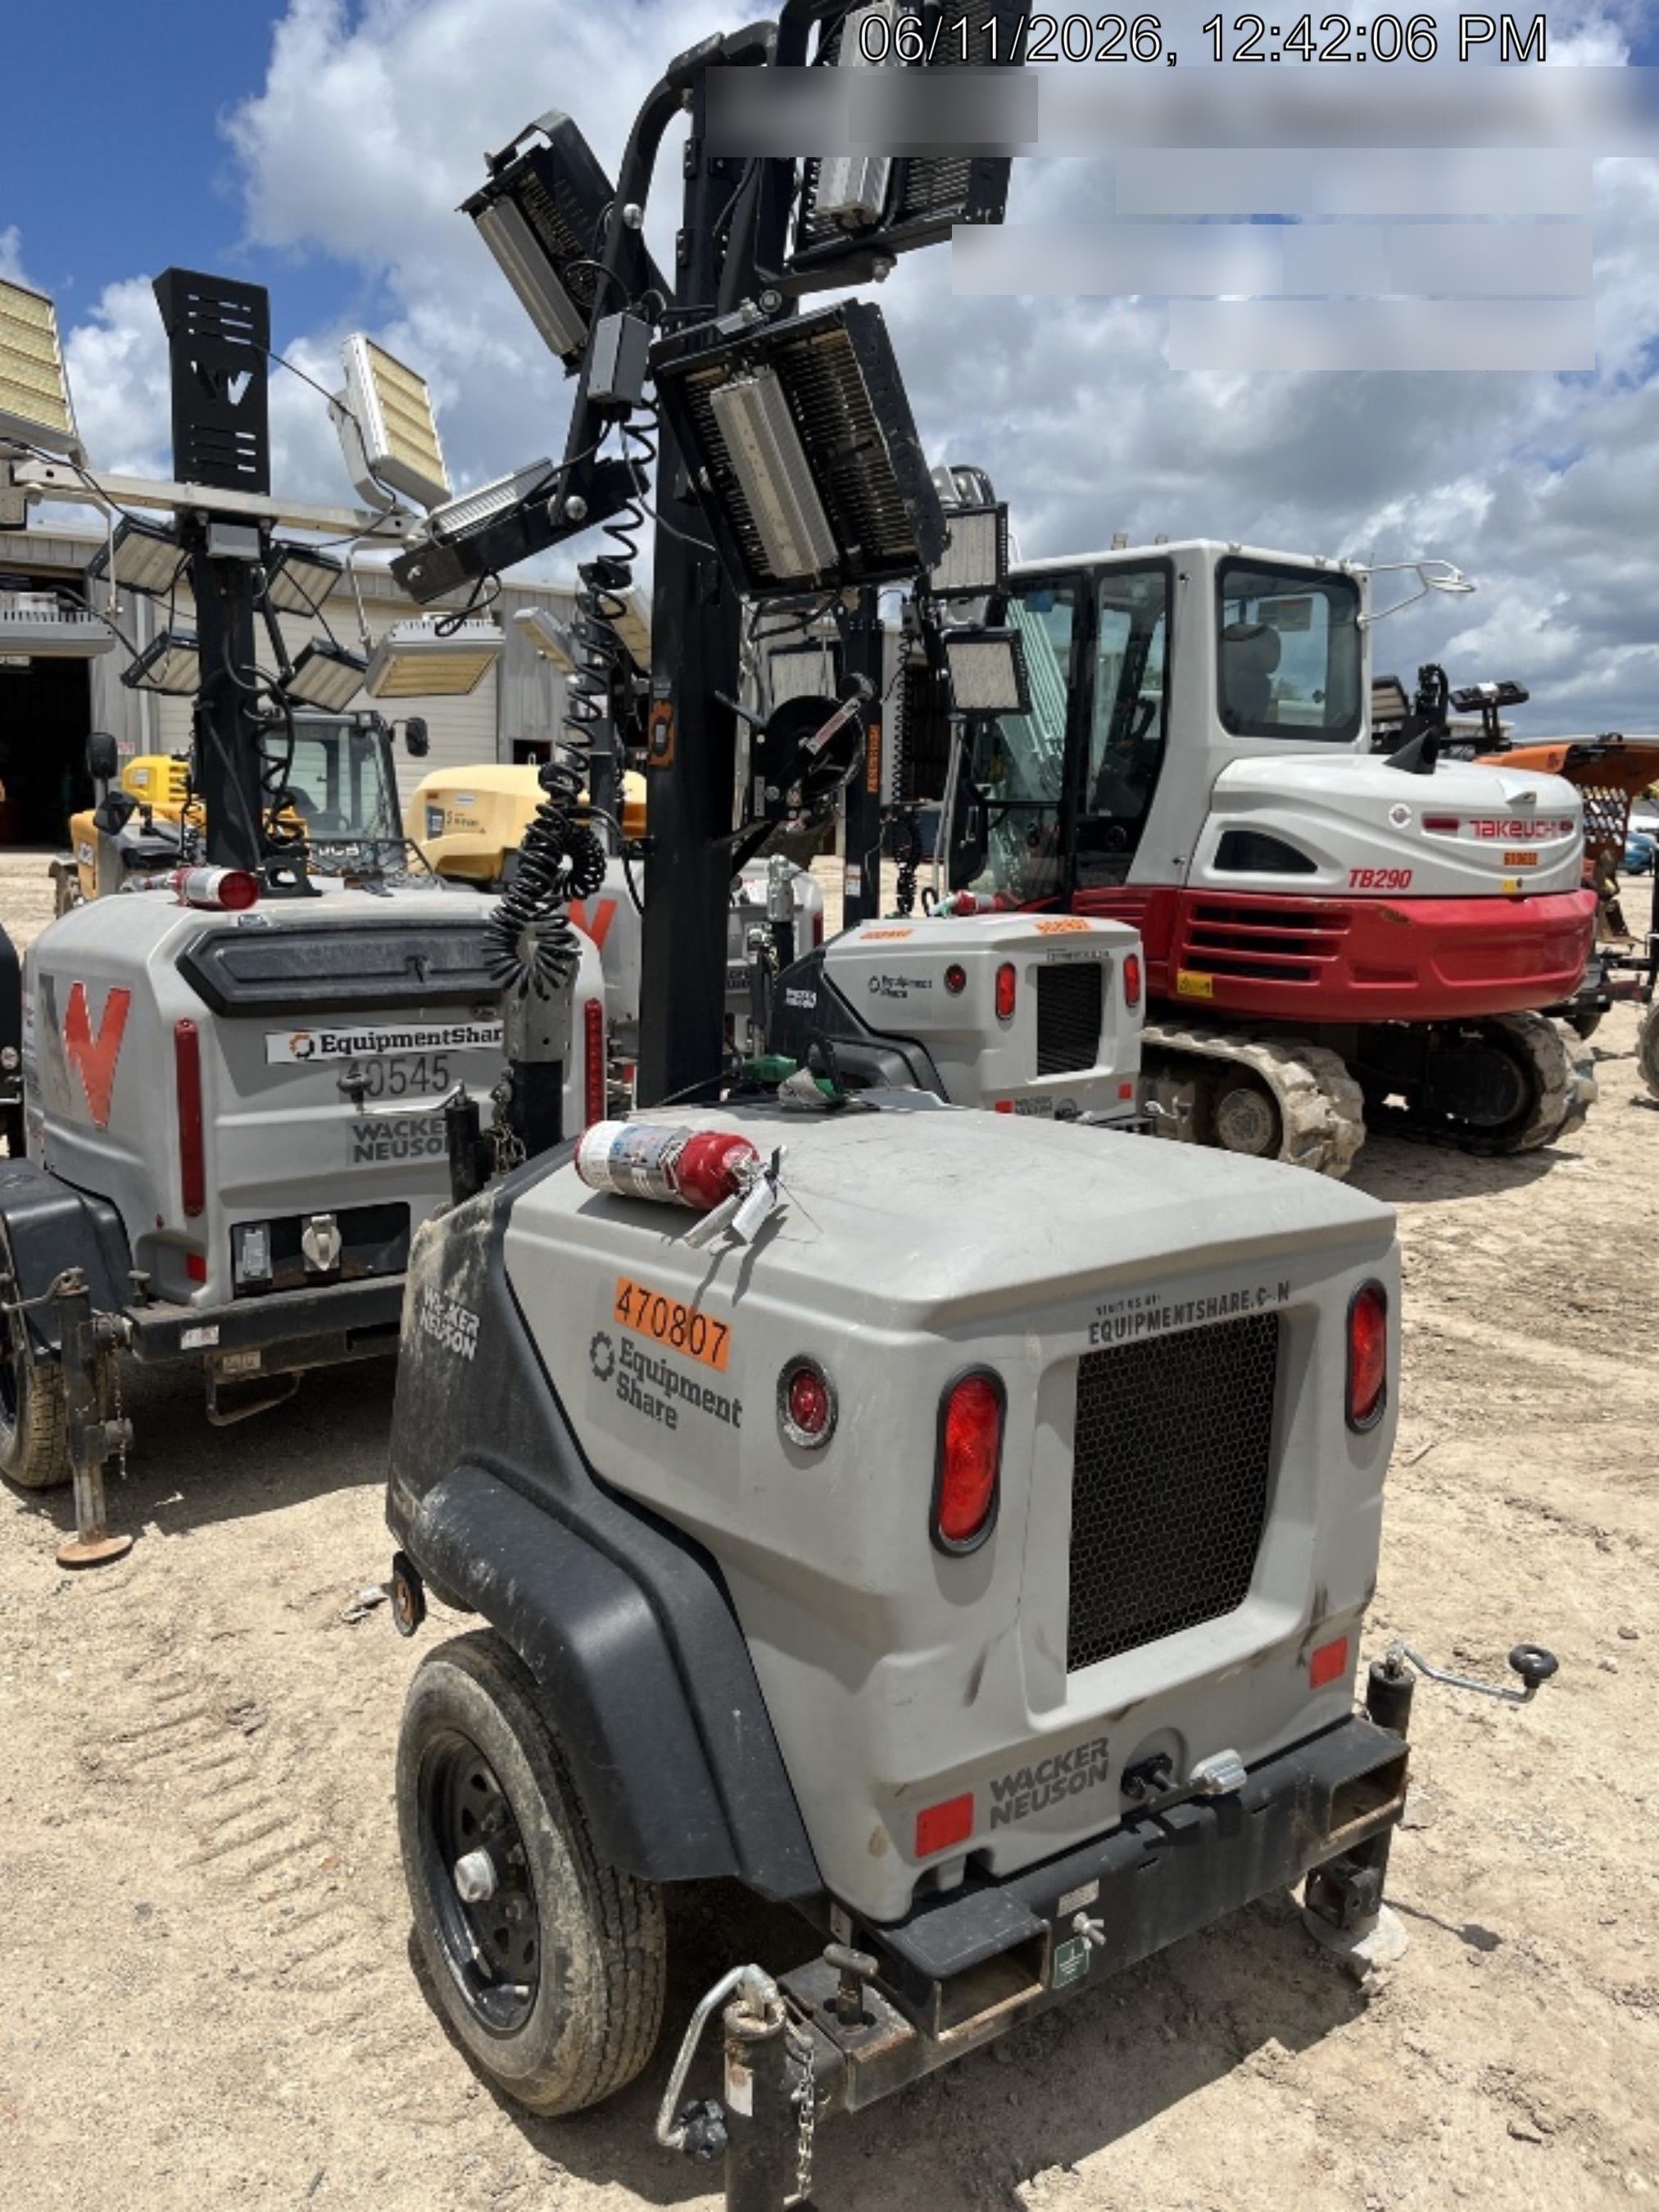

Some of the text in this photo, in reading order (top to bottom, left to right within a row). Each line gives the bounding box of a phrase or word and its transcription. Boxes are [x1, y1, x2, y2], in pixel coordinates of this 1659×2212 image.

[1349, 869, 1412, 888] TB290
[320, 1027, 503, 1055] EquipmentShar
[352, 1118, 448, 1142] WACKE
[353, 1137, 450, 1163] NEUSO
[616, 1283, 728, 1364] 470807
[616, 1371, 678, 1430] Share
[619, 1336, 743, 1429] Equipment
[990, 1737, 1109, 1802] WACKER
[990, 1759, 1108, 1832] NEUSON
